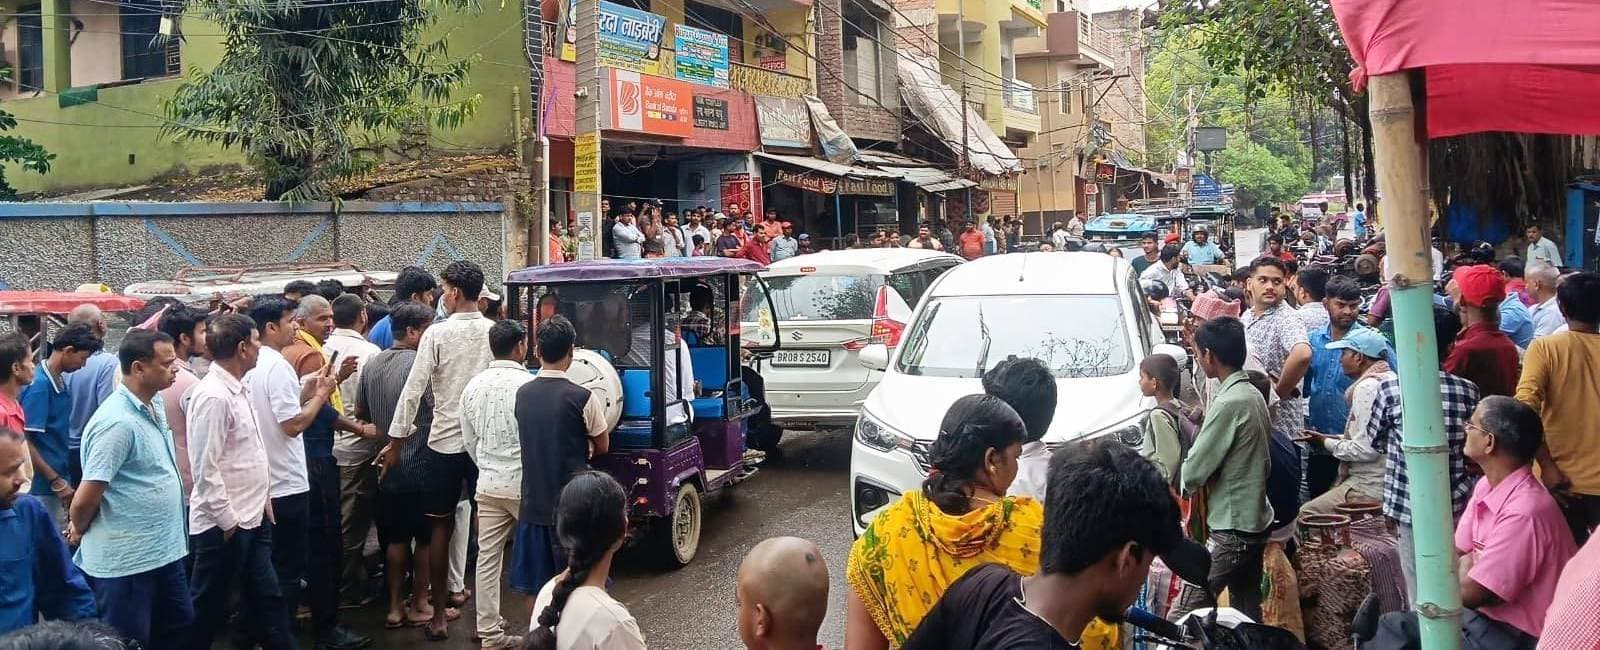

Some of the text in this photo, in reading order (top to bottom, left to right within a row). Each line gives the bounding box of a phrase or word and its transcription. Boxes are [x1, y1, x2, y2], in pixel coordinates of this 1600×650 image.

[600, 12, 618, 33] रदा
[622, 15, 660, 43] लाइब्रेरी
[761, 61, 784, 70] OFFICE
[776, 169, 820, 188] Fast Food
[845, 180, 888, 194] Fast Food
[777, 352, 826, 363] BR08 S 2540
